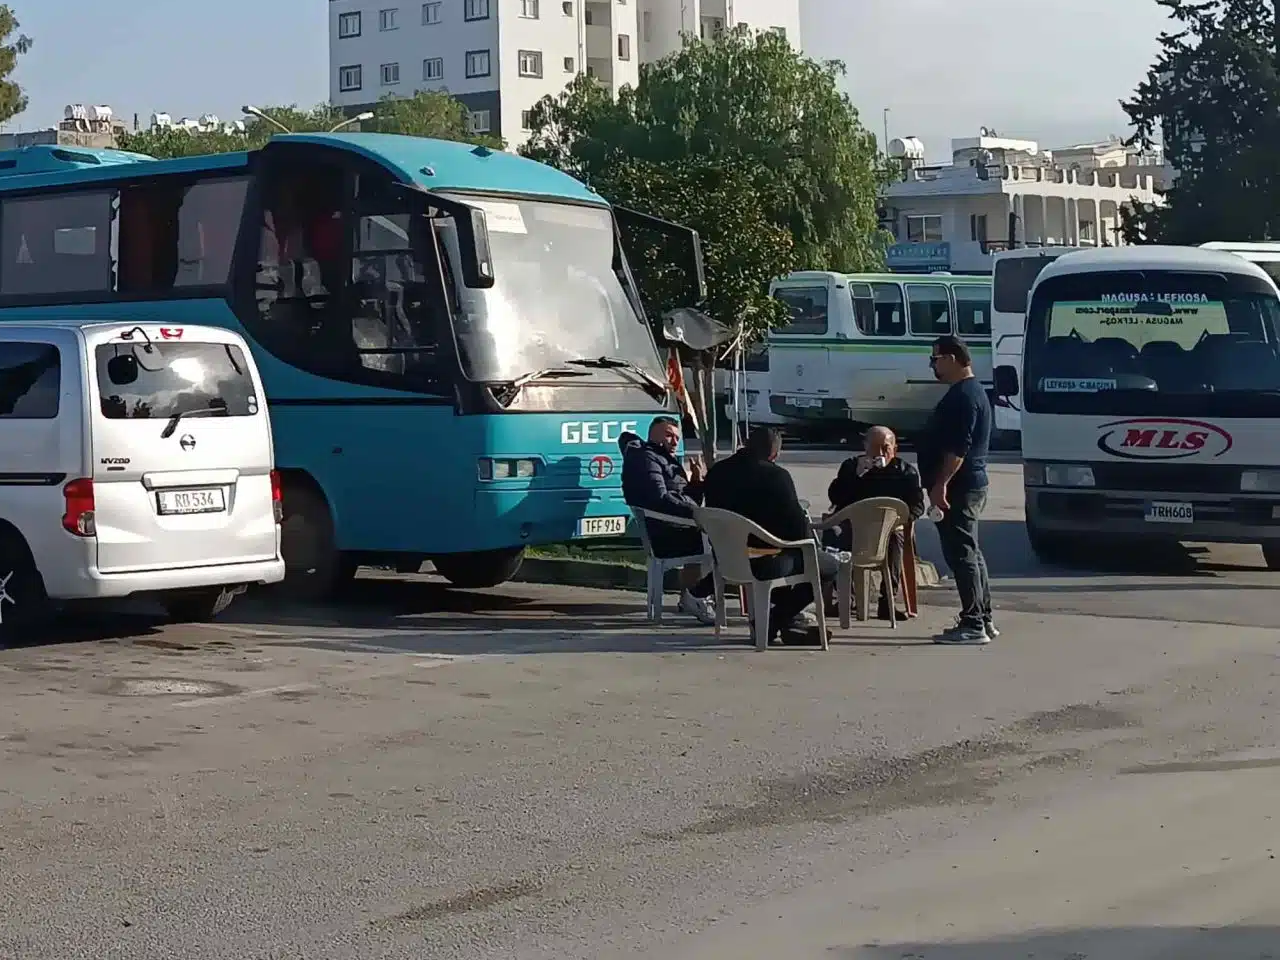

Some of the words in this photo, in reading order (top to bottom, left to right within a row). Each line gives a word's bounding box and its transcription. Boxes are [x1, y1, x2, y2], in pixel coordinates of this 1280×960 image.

[1120, 429, 1209, 450] MLS
[585, 521, 602, 533] TFF
[605, 520, 621, 532] 916
